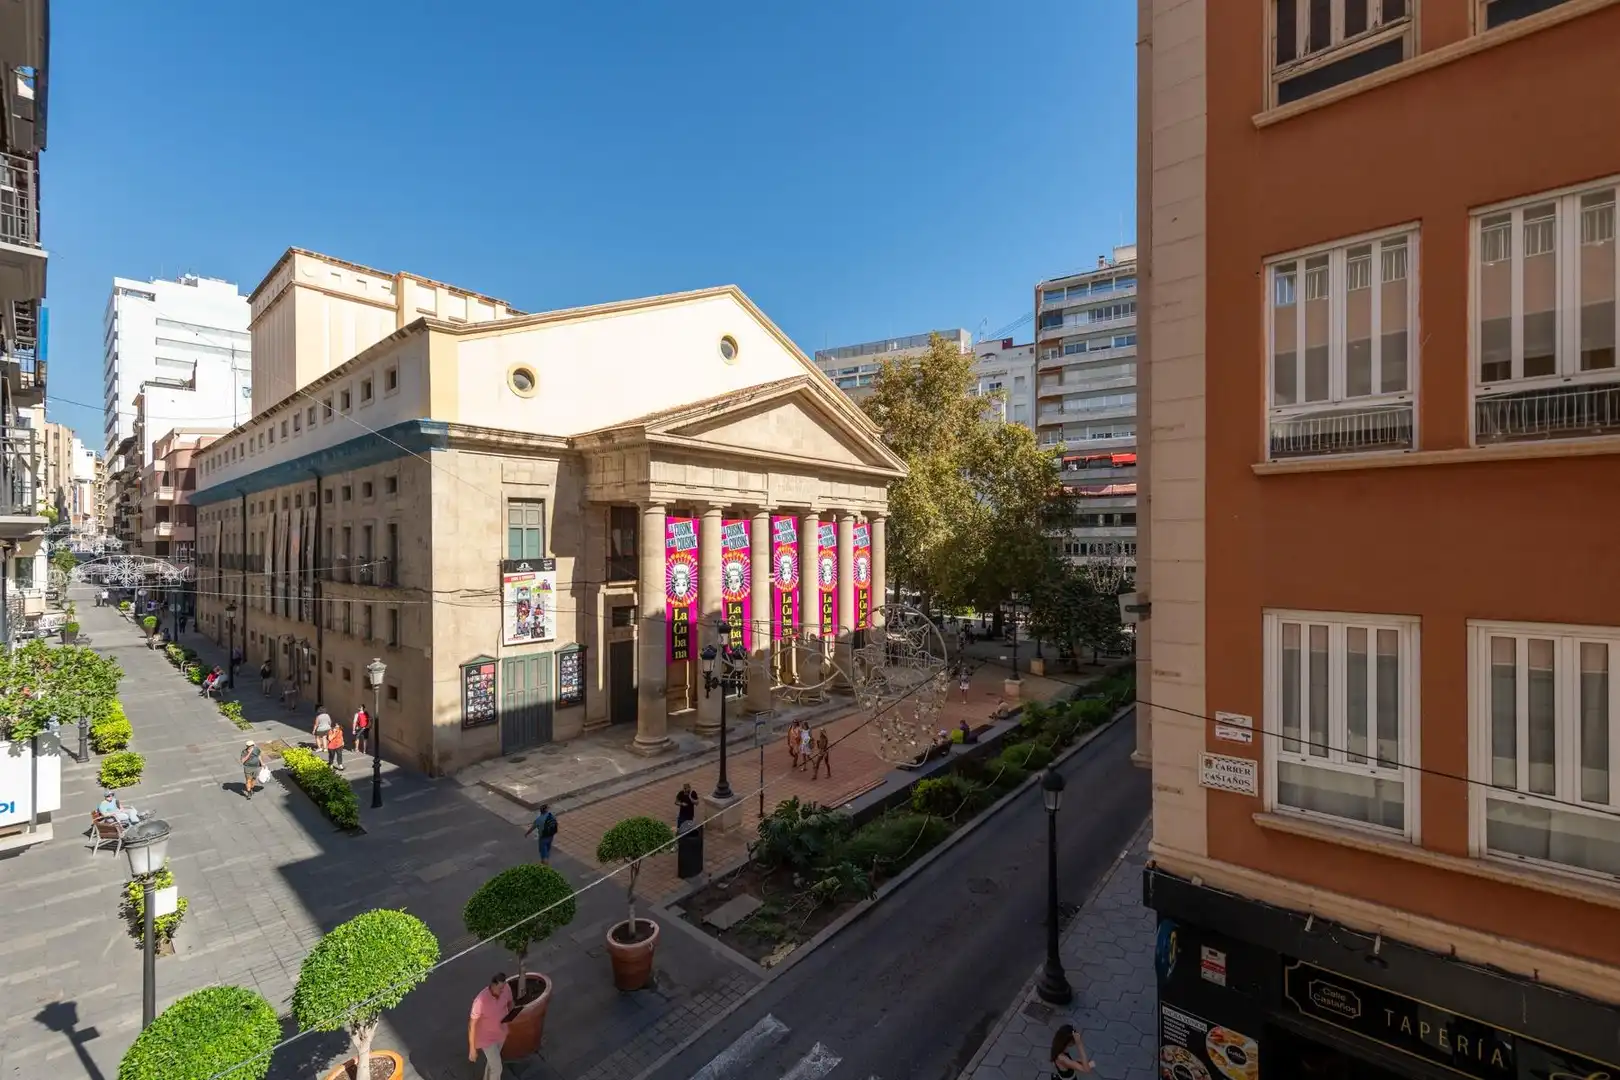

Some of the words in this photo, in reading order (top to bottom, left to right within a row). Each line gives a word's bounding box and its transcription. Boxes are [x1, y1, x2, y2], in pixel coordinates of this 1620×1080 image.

[783, 594, 792, 604] La
[824, 594, 832, 603] La
[860, 590, 867, 599] La
[728, 604, 741, 614] La
[782, 605, 792, 614] Cu
[823, 605, 832, 613] Cu
[674, 609, 687, 620] La
[674, 622, 687, 634] Cu
[730, 628, 741, 638] ba
[674, 635, 686, 647] ba
[675, 650, 687, 659] na
[1216, 764, 1251, 776] CARRER
[1205, 773, 1250, 786] CASTAÑOS
[1322, 987, 1346, 1002] Calle
[1313, 992, 1357, 1013] Castaños
[1384, 1008, 1504, 1068] TAPERÍA
